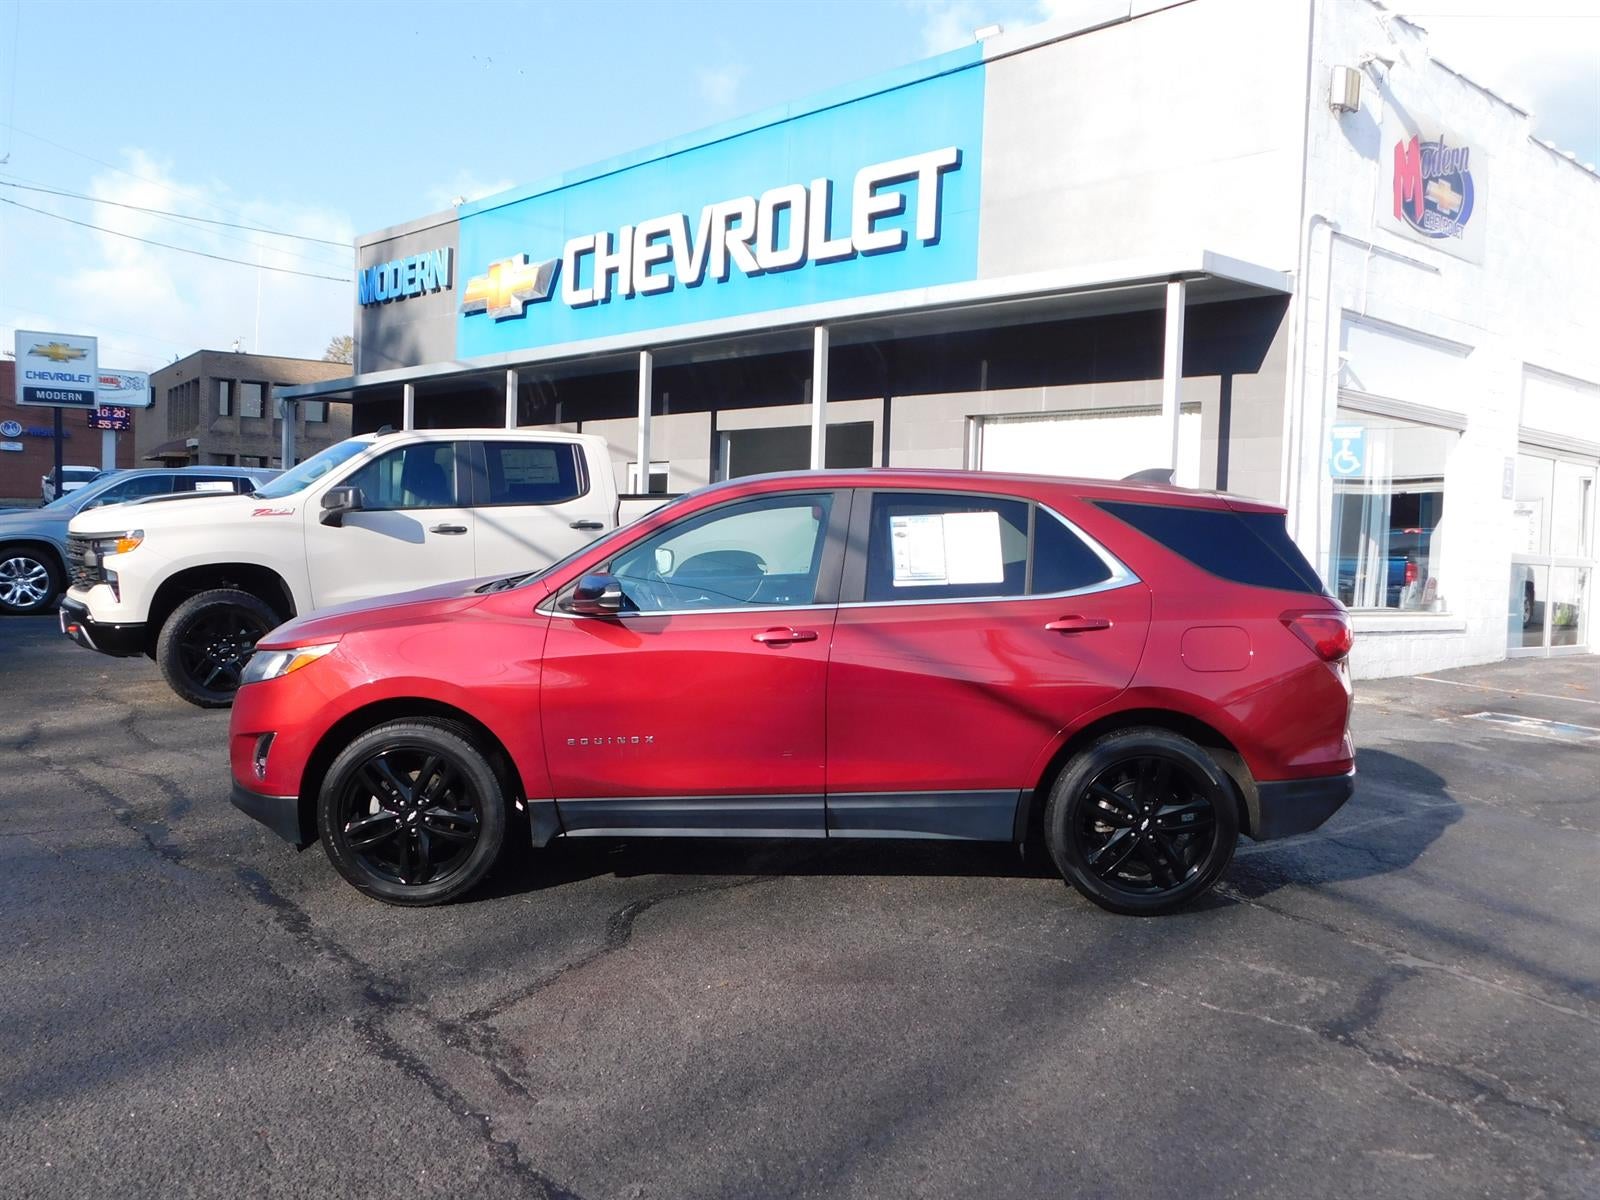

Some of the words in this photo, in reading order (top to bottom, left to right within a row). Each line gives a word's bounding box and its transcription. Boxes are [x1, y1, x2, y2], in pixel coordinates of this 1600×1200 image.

[1393, 134, 1470, 224] Modern
[563, 147, 960, 307] CHEVROLET
[358, 246, 450, 305] MODERN
[26, 371, 92, 383] CHEVROLET
[36, 390, 83, 401] MODERN
[567, 735, 654, 746] EQUINOX
